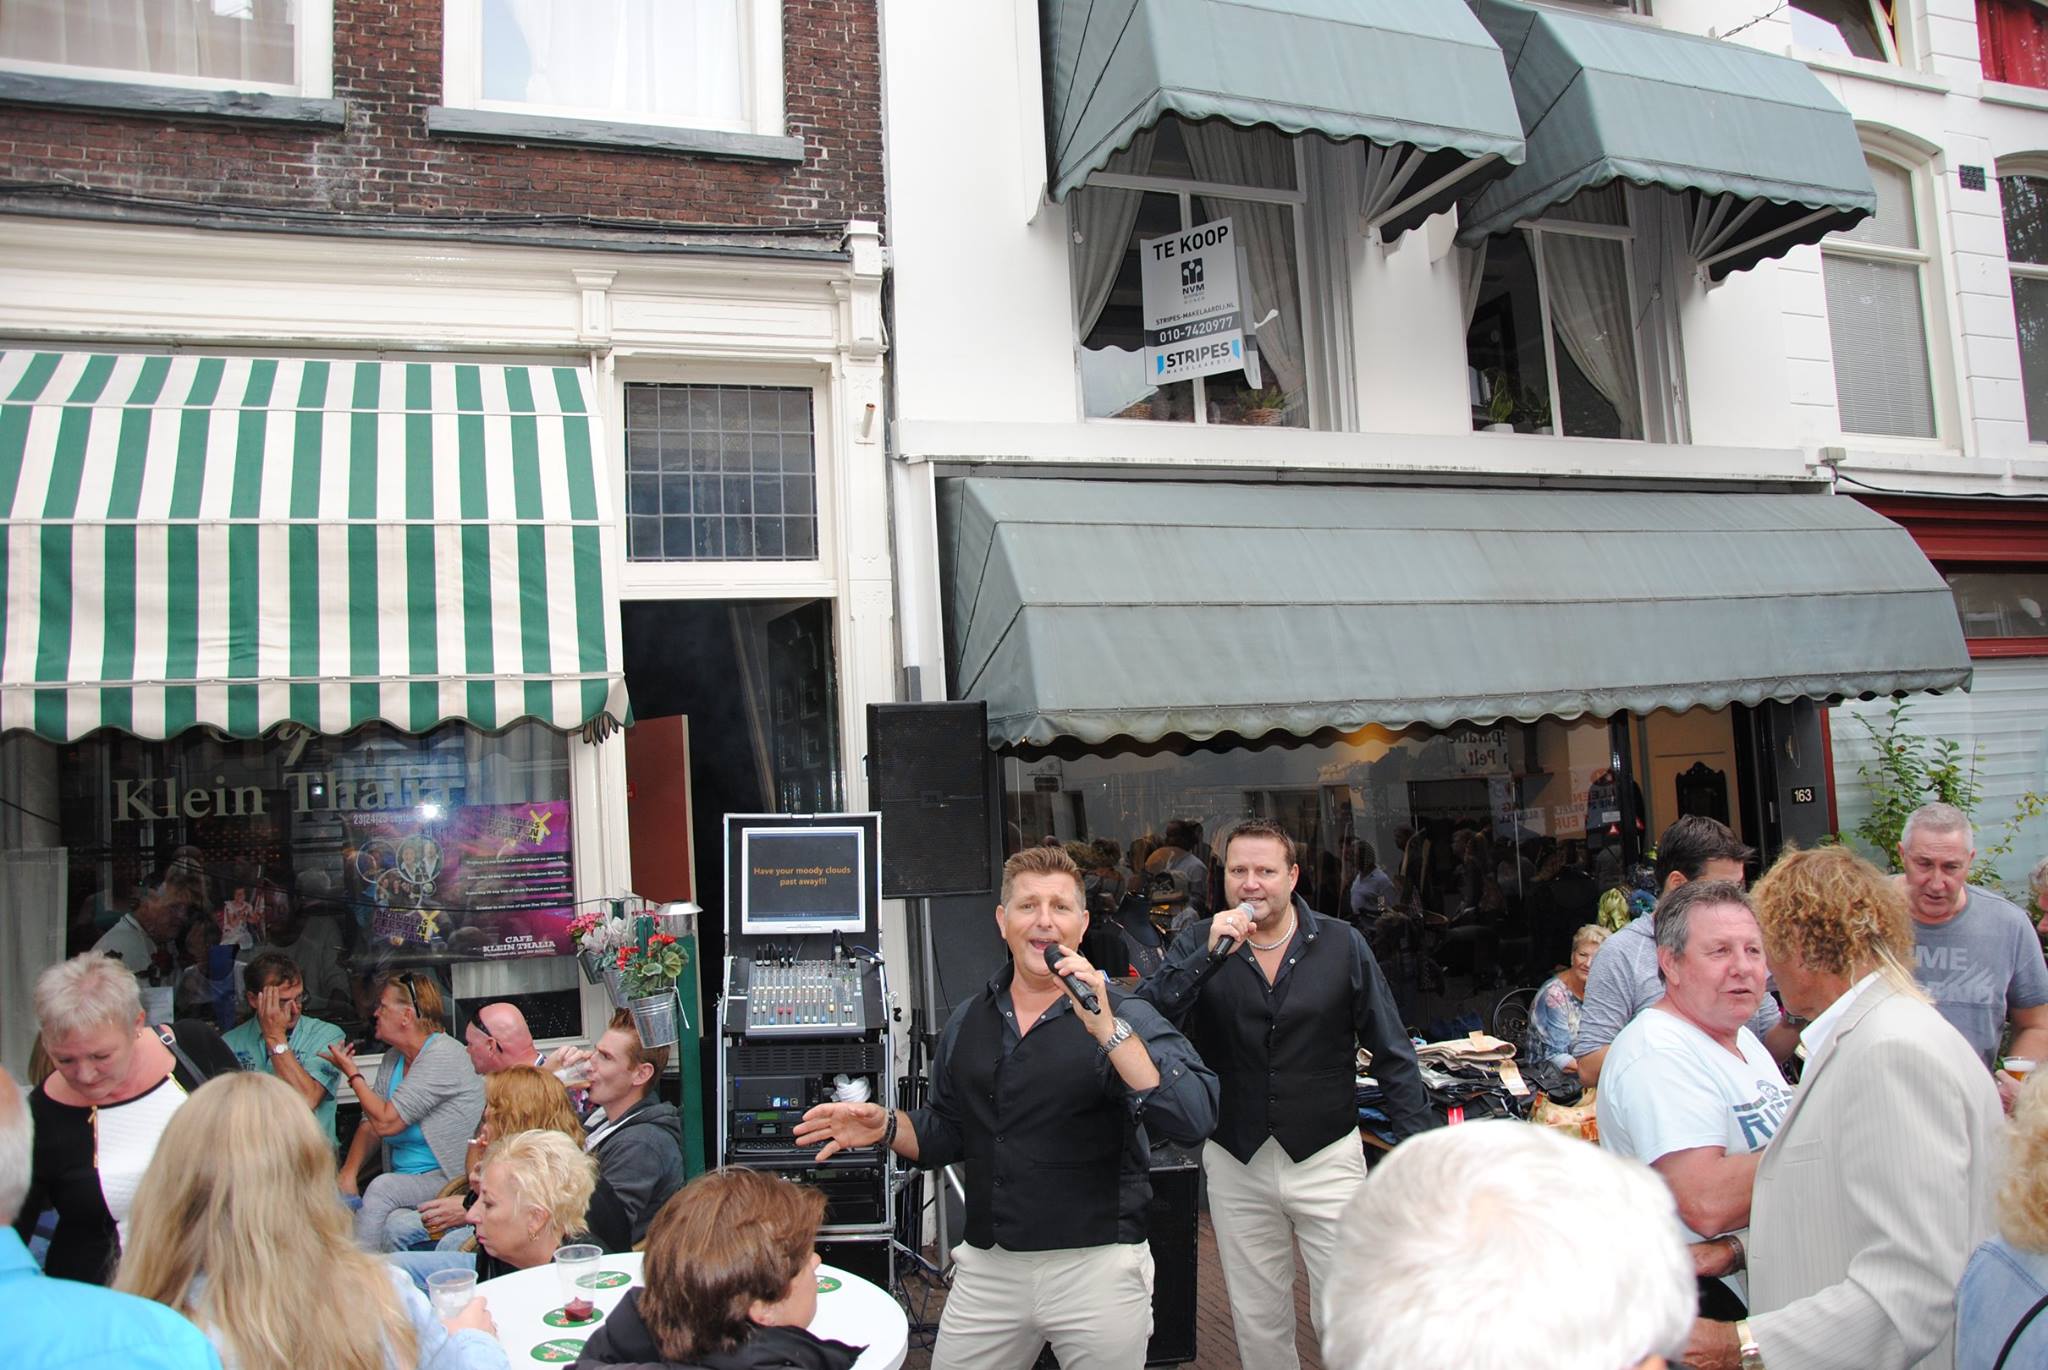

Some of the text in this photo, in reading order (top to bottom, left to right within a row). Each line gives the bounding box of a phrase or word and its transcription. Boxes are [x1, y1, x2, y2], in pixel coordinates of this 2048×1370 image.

[1153, 226, 1228, 260] TE KOOP
[1182, 283, 1205, 295] NVM
[1155, 302, 1235, 325] STRIPES-MAKELAARDIJ.NL
[1160, 316, 1233, 343] 010-7420977
[1166, 342, 1230, 368] STRIPES
[112, 776, 267, 821] Klein
[1794, 788, 1812, 802] 163
[753, 866, 851, 876] Have your moody clouds
[780, 878, 797, 886] past
[482, 943, 515, 953] KLEIN
[516, 940, 556, 950] THALIA
